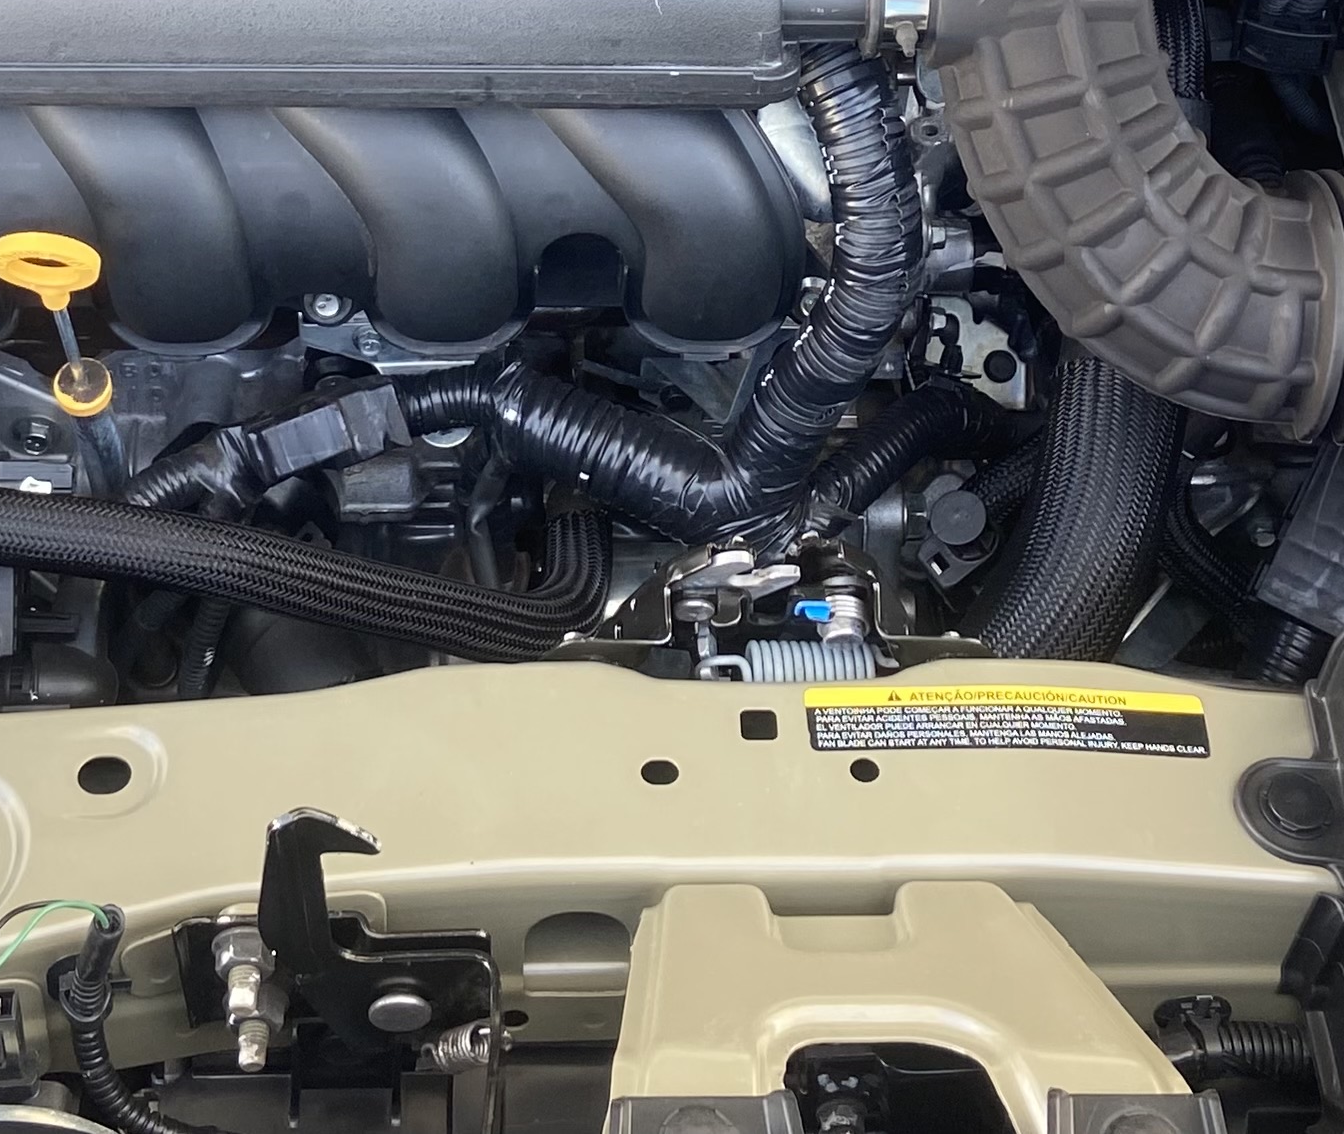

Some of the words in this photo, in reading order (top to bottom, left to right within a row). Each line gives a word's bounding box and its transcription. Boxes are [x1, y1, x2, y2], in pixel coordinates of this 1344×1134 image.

[960, 705, 1014, 713] FUNCIONAR
[1023, 706, 1073, 715] QUALQUER
[816, 715, 841, 723] PARA
[842, 715, 874, 723] EVITAR
[876, 714, 928, 722] ACIDENTES
[829, 723, 884, 731] VENTILADOR
[885, 722, 915, 730] PUEDE
[916, 722, 964, 730] ARRANCAR
[979, 721, 1031, 729] CUALQUIER
[817, 732, 841, 740] PARA
[842, 731, 872, 739] EVITAR
[874, 730, 906, 739] DAÑOS
[1038, 730, 1070, 738] MANOS
[838, 739, 867, 747] BLADE
[888, 738, 916, 746] START
[929, 738, 947, 746] ANY
[988, 737, 1011, 745] HELP
[1012, 737, 1039, 745] AVOID
[1040, 737, 1087, 747] PERSONAL
[1121, 742, 1145, 750] KEEP
[1146, 744, 1175, 752] HANDS
